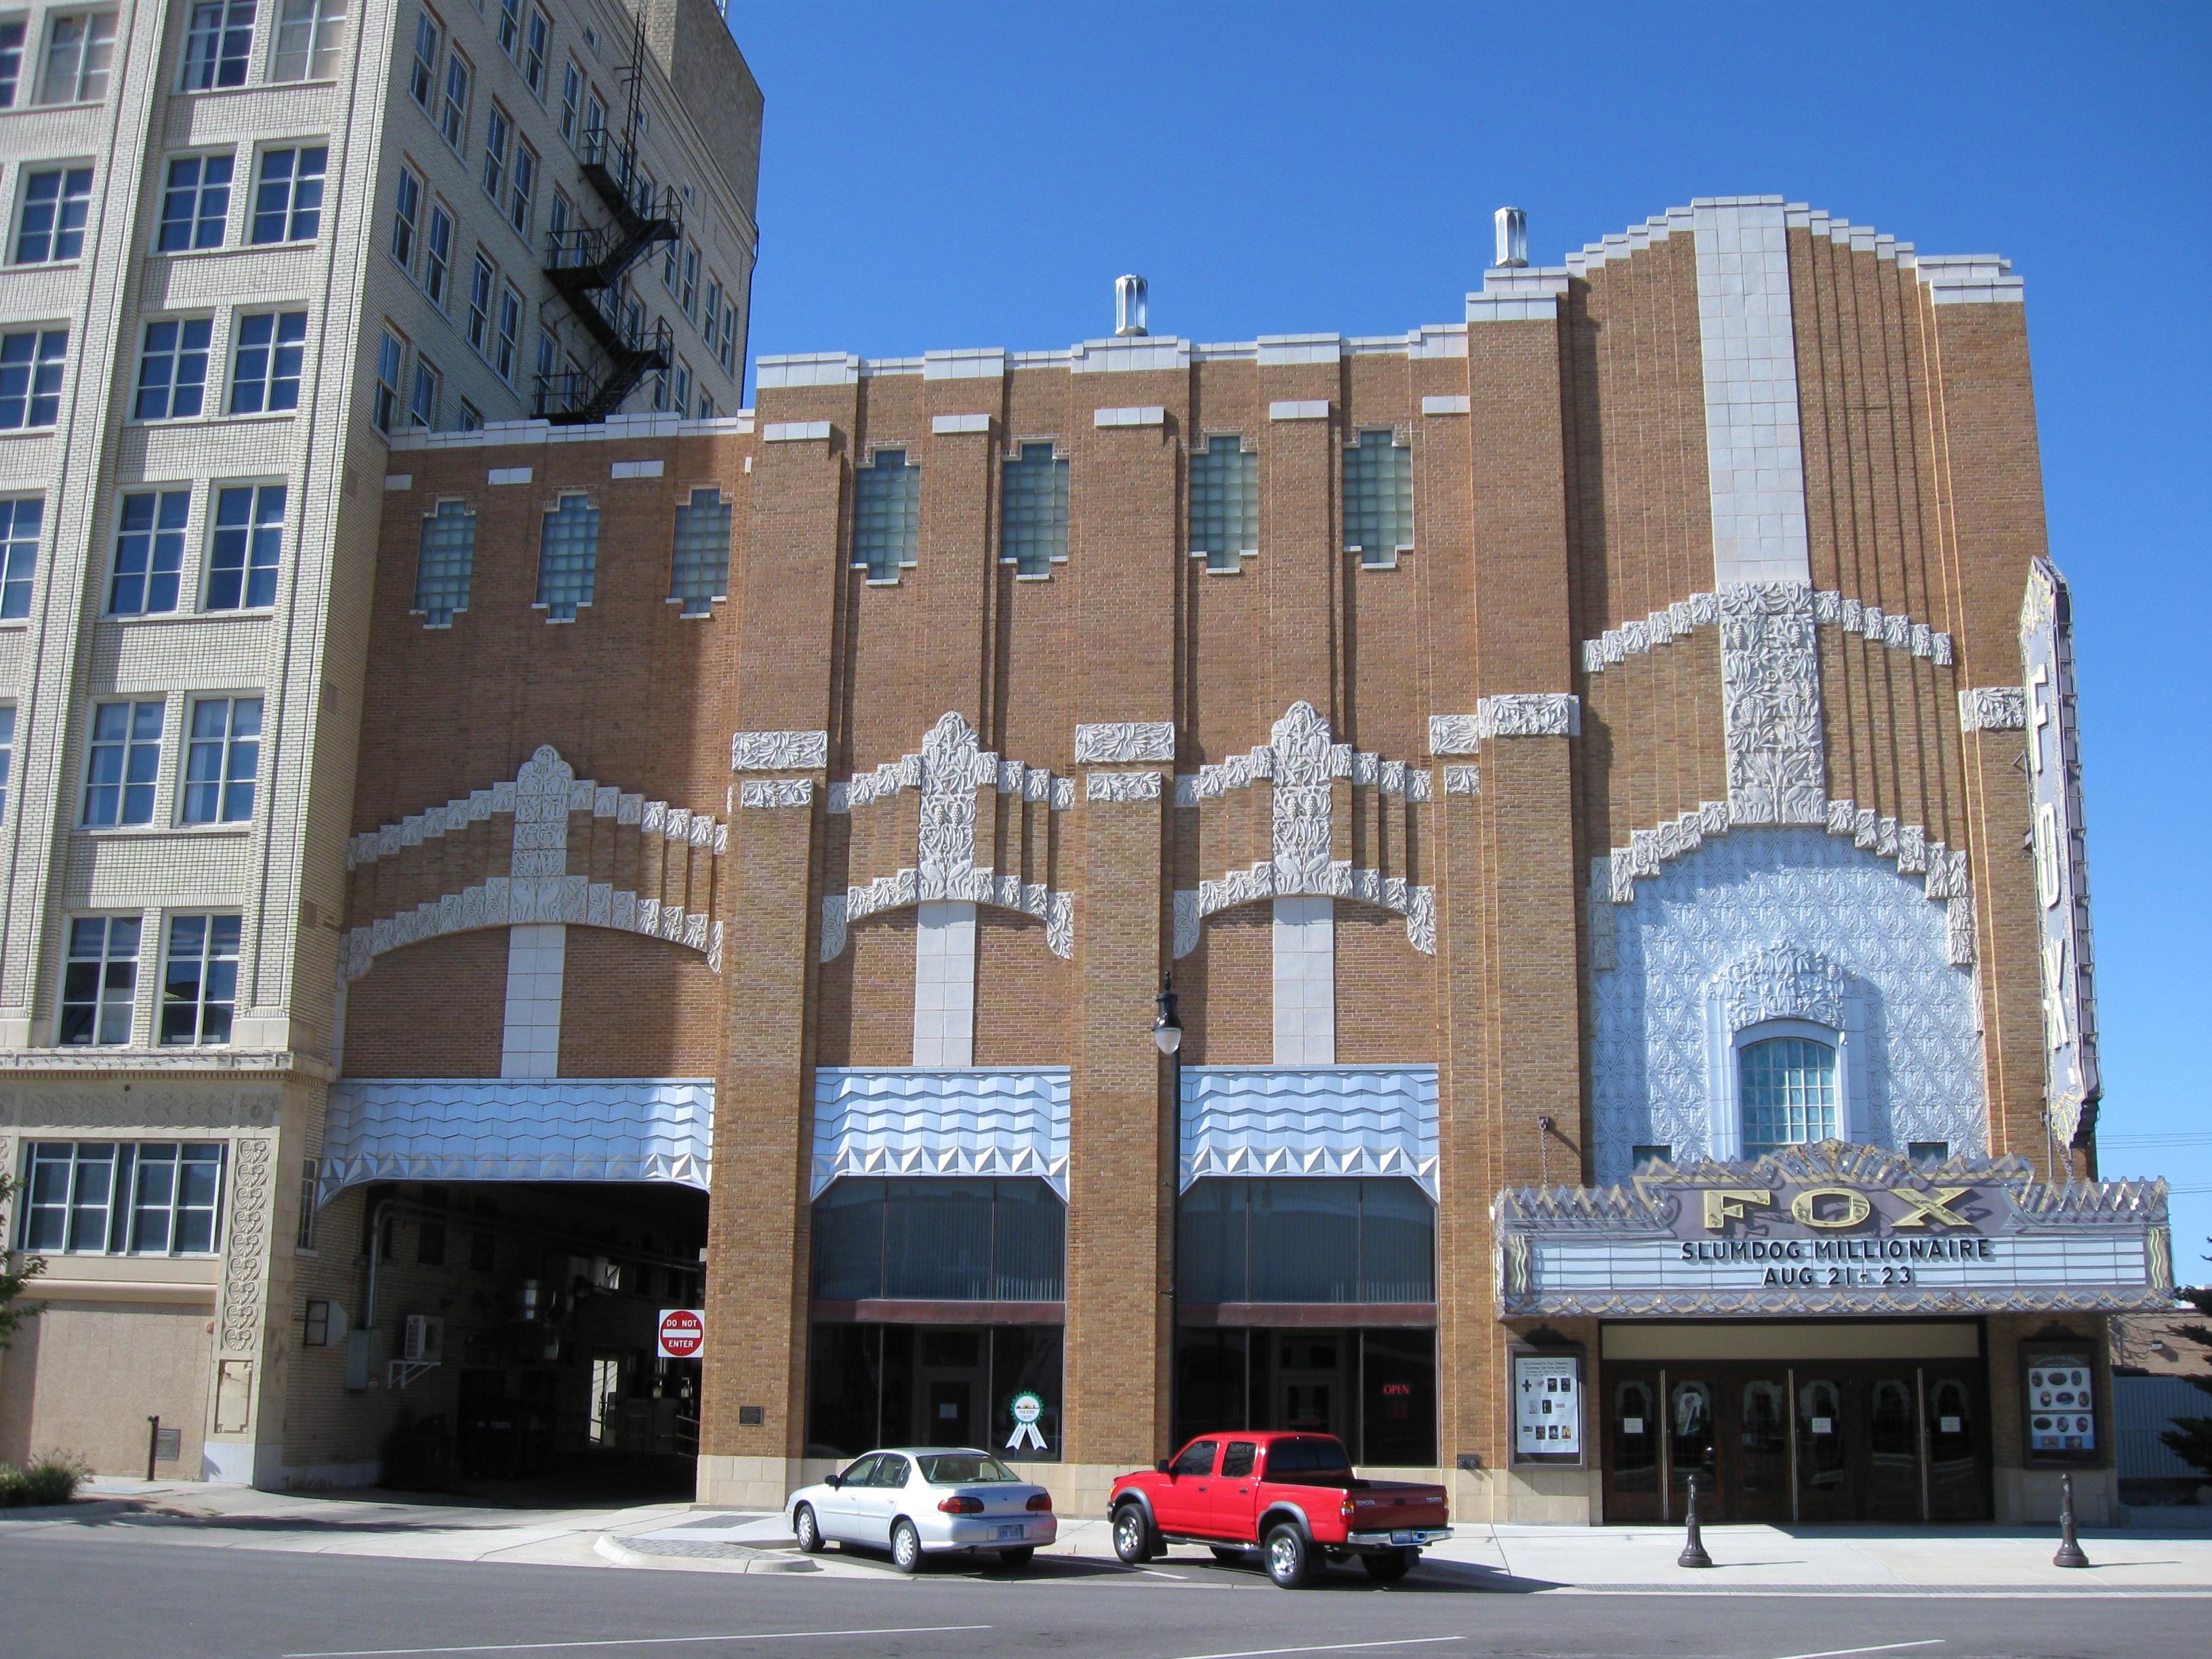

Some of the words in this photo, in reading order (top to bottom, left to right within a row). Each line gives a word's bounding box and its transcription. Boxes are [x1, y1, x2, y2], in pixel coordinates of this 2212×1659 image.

[2028, 662, 2070, 1051] FOX
[1703, 1187, 1972, 1228] FOX
[1679, 1241, 1800, 1261] SLUMDOG
[1814, 1239, 1990, 1260] MILLIONAIRE
[1762, 1267, 1813, 1286] AUG
[666, 1319, 678, 1327] DO
[682, 1319, 697, 1328] NOT
[668, 1340, 694, 1348] ENTER
[1383, 1384, 1410, 1395] OPEN
